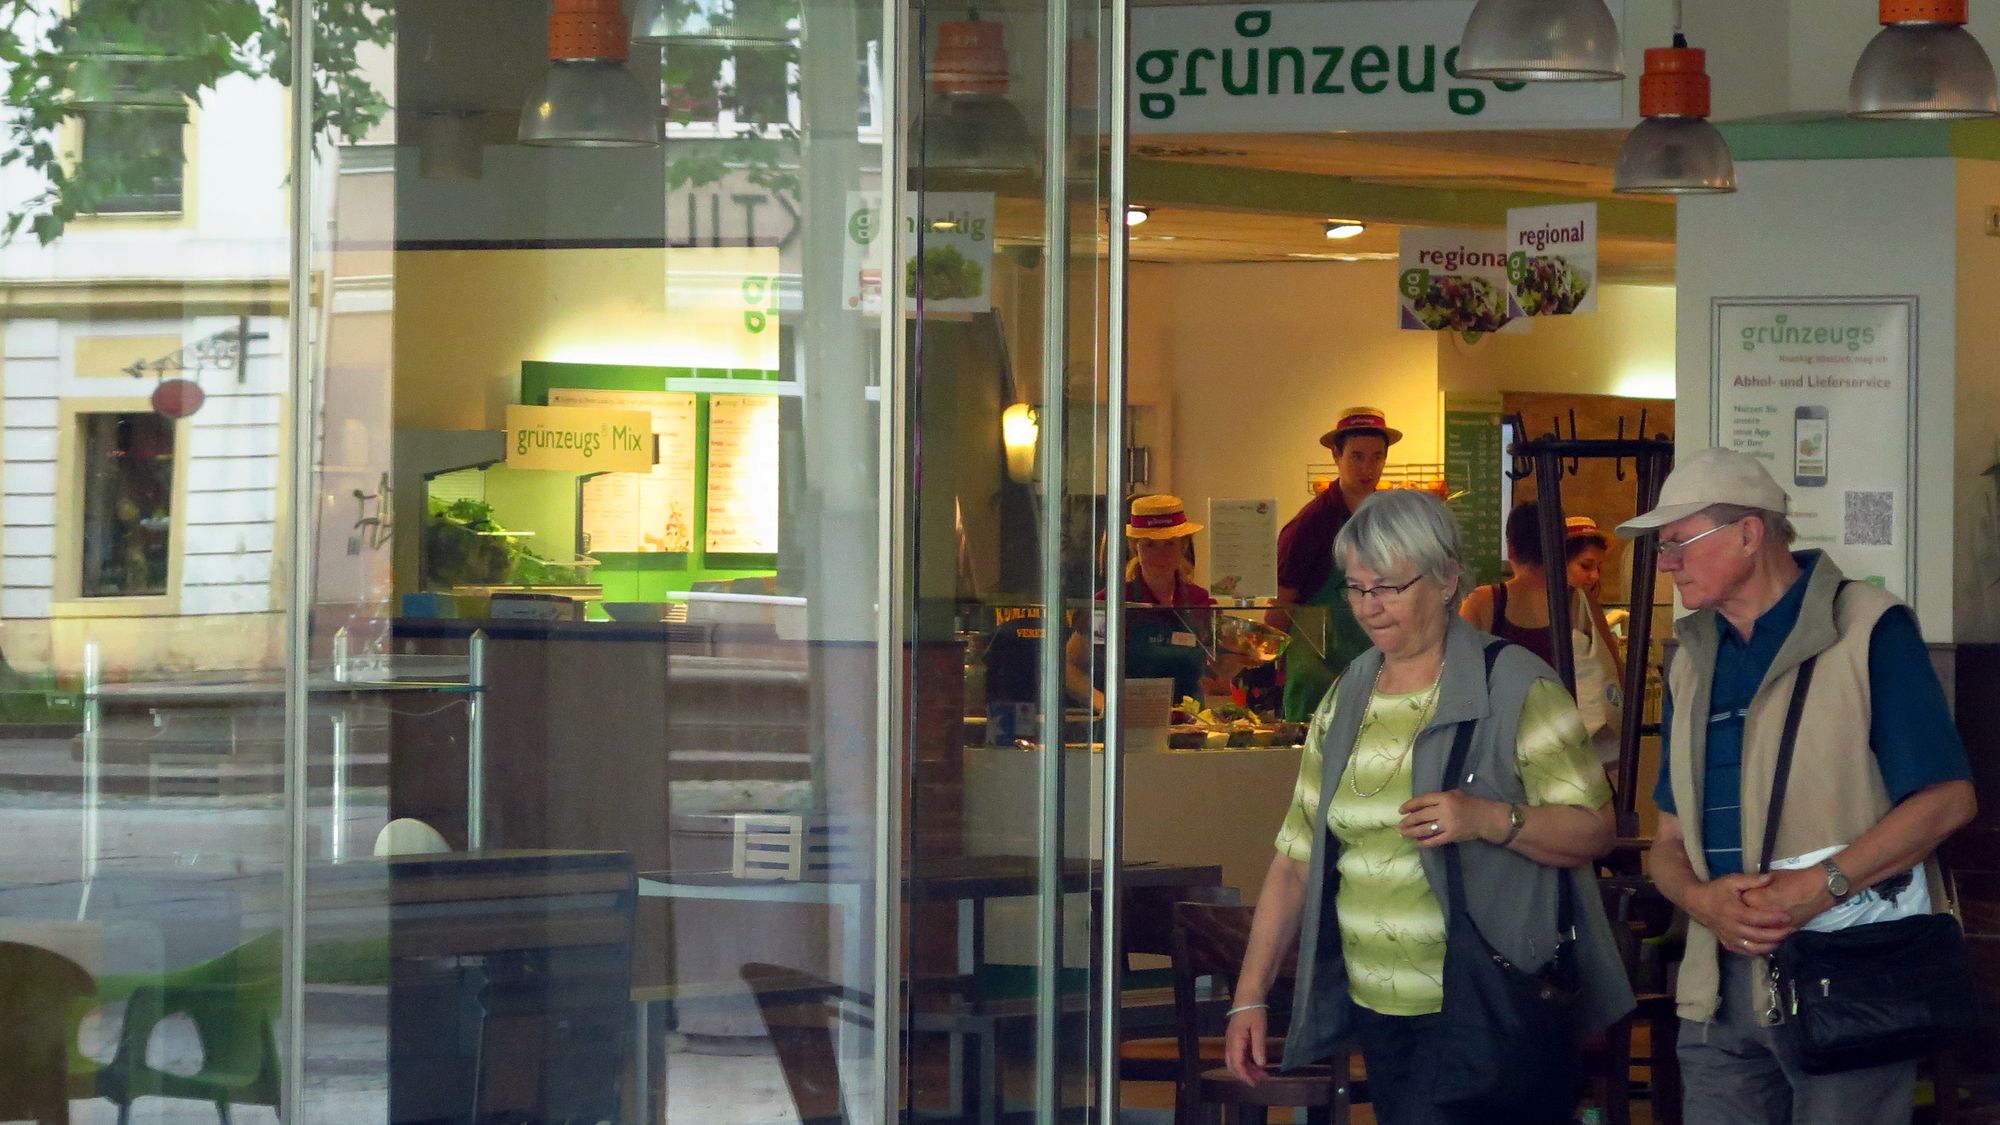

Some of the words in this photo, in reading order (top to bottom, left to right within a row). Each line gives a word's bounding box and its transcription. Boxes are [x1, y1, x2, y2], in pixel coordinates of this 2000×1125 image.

[1136, 10, 1527, 119] grünzeug
[1519, 220, 1585, 251] regional
[1419, 246, 1508, 271] regiona
[1741, 314, 1875, 351] grünzeugs
[1733, 375, 1776, 388] Abhol-
[1780, 376, 1803, 388] und
[1808, 375, 1892, 389] Lieferservice
[612, 425, 642, 451] Mix
